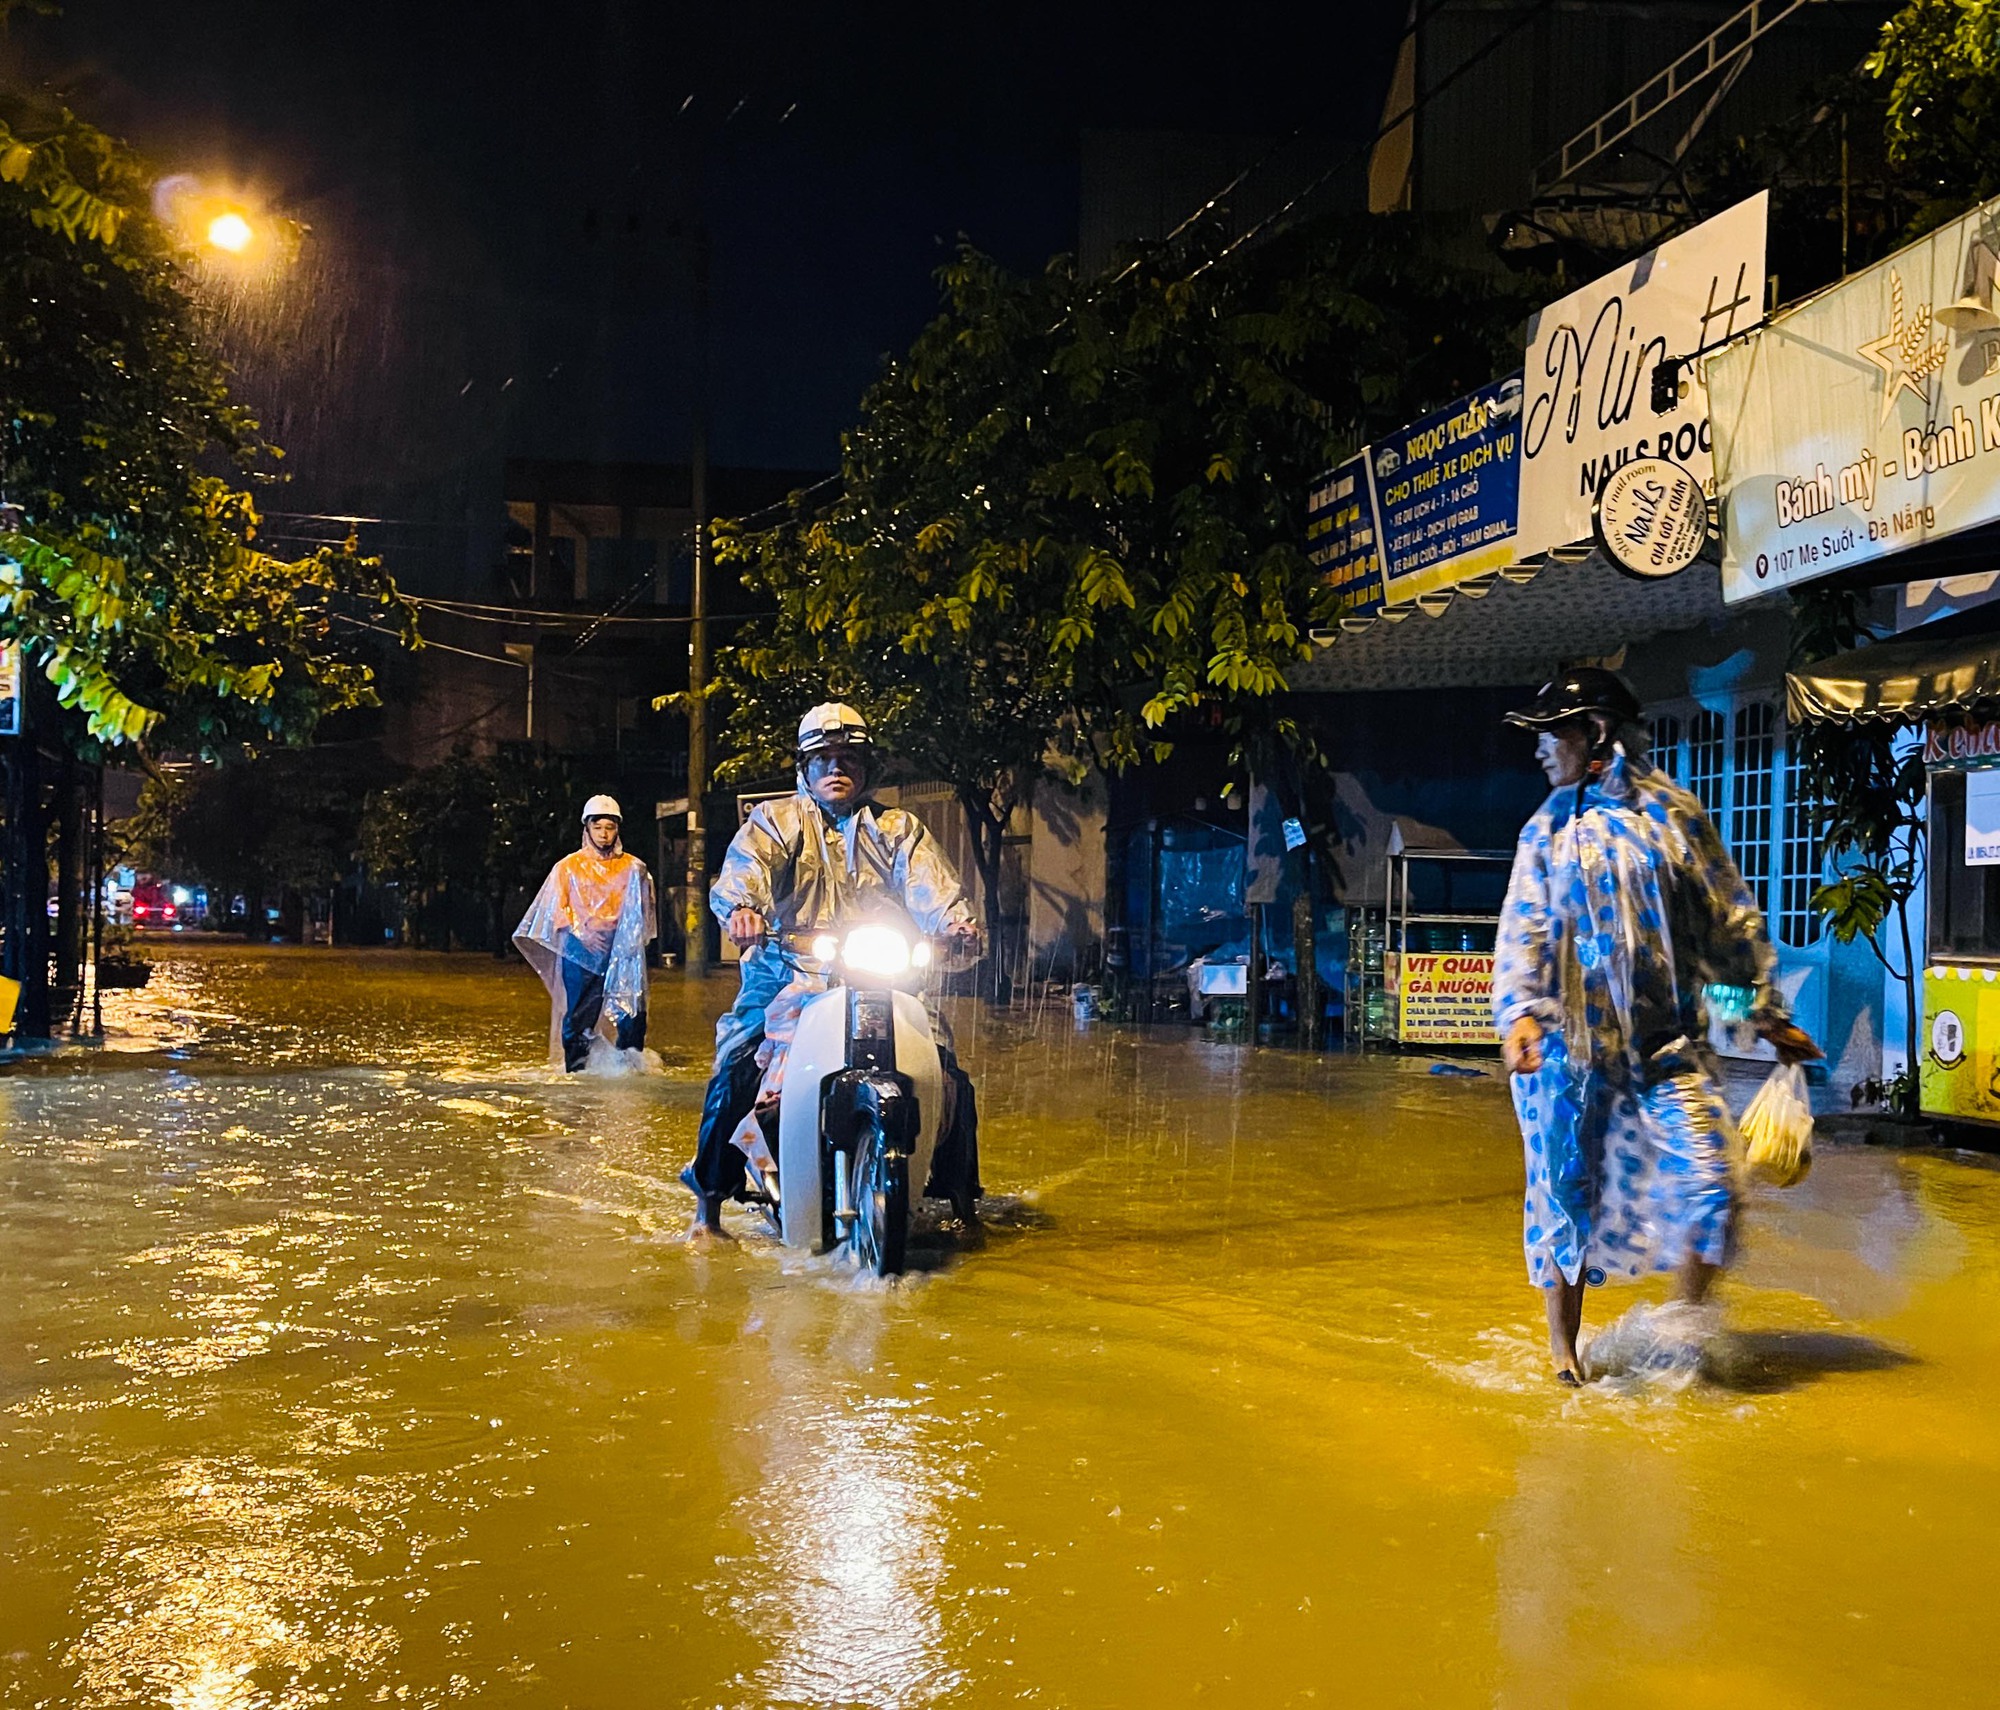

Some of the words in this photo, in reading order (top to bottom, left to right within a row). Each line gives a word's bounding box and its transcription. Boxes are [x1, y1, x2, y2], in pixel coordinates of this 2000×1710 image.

[1406, 423, 1446, 465] NGỌC
[1447, 396, 1489, 444] TUẤN
[1385, 481, 1410, 507] CHO
[1413, 462, 1440, 494] THUÊ
[1443, 458, 1458, 482] XE
[1460, 442, 1493, 476] DỊCH
[1496, 432, 1514, 463] VỤ
[1625, 465, 1656, 481] room
[1775, 463, 1835, 528] Bánh
[1838, 448, 1877, 511] mỳ
[1883, 460, 1898, 478] -
[1903, 405, 1975, 480] Bánh
[1624, 480, 1666, 546] Nails
[1659, 513, 1676, 539] GÓT
[1669, 479, 1688, 512] CHÂN
[1773, 550, 1794, 573] 107
[1799, 544, 1819, 567] Mẹ
[1822, 526, 1855, 558] Suốt
[1868, 516, 1889, 542] Đà
[1892, 502, 1936, 534] Nẵng
[1407, 957, 1438, 977] VỊT
[1442, 958, 1495, 974] QUAY
[1409, 976, 1433, 993] GÀ
